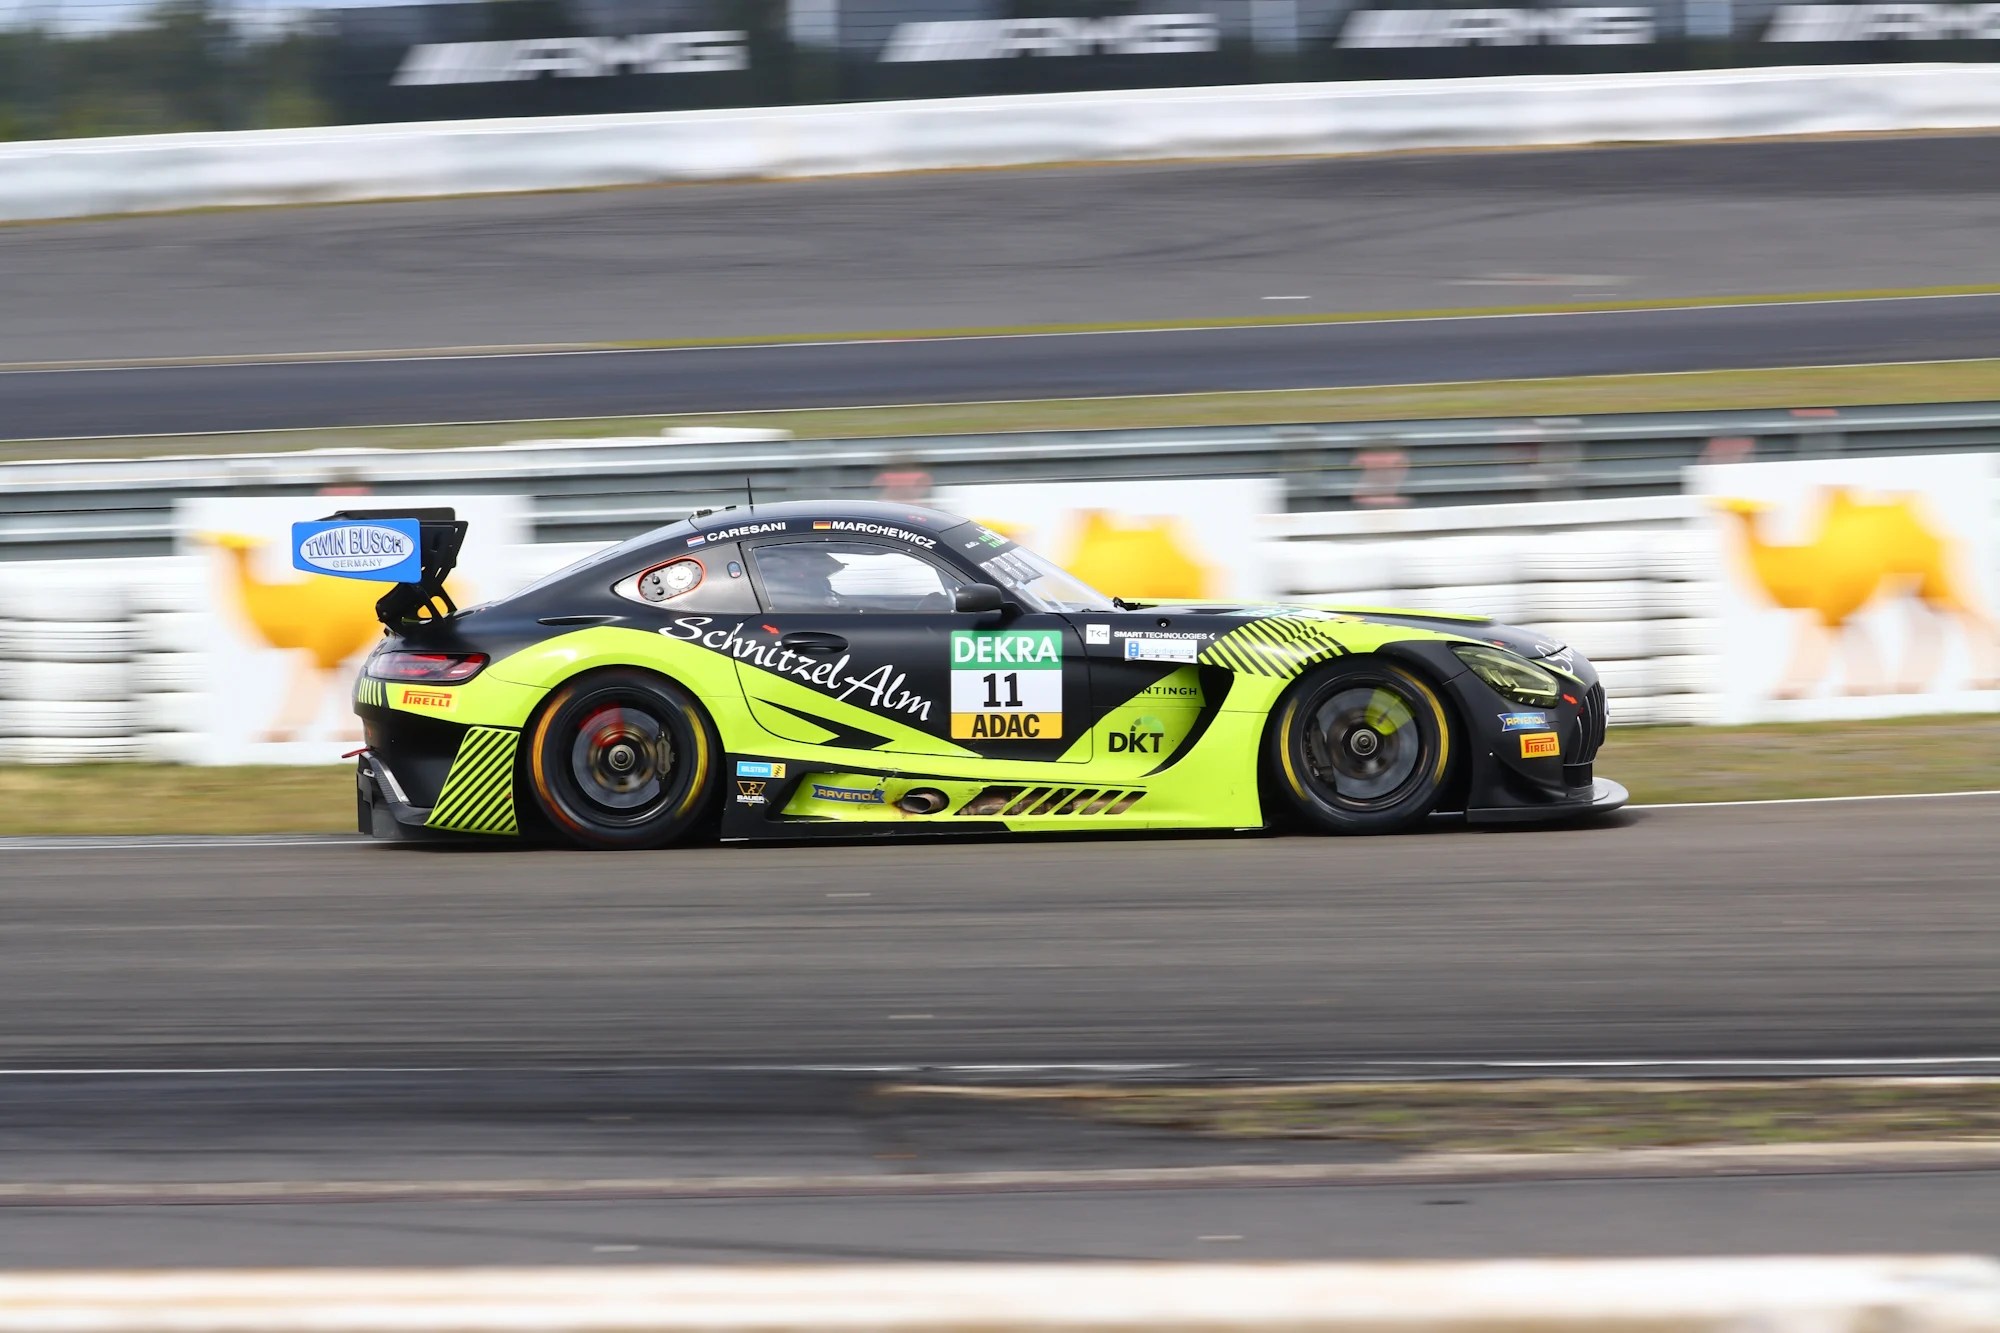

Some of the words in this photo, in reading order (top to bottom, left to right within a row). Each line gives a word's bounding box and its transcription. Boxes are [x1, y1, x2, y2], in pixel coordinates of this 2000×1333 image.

[707, 522, 786, 542] CARESANI
[831, 521, 937, 550] MARCHEWICZ
[306, 529, 346, 556] TWIN
[349, 528, 403, 554] BUSCH
[332, 558, 382, 568] GERMANY
[1145, 632, 1207, 640] TECHNOLOGIES
[954, 636, 1059, 662] DEKRA
[402, 690, 452, 707] PIRELLI
[983, 672, 1023, 707] 11
[971, 714, 1040, 737] ADAC
[1505, 716, 1546, 727] RAVENOL
[1108, 732, 1164, 753] DKT
[1525, 737, 1556, 754] PIRELLI
[740, 765, 769, 774] BILSTEIN
[818, 788, 880, 801] RAVENOL
